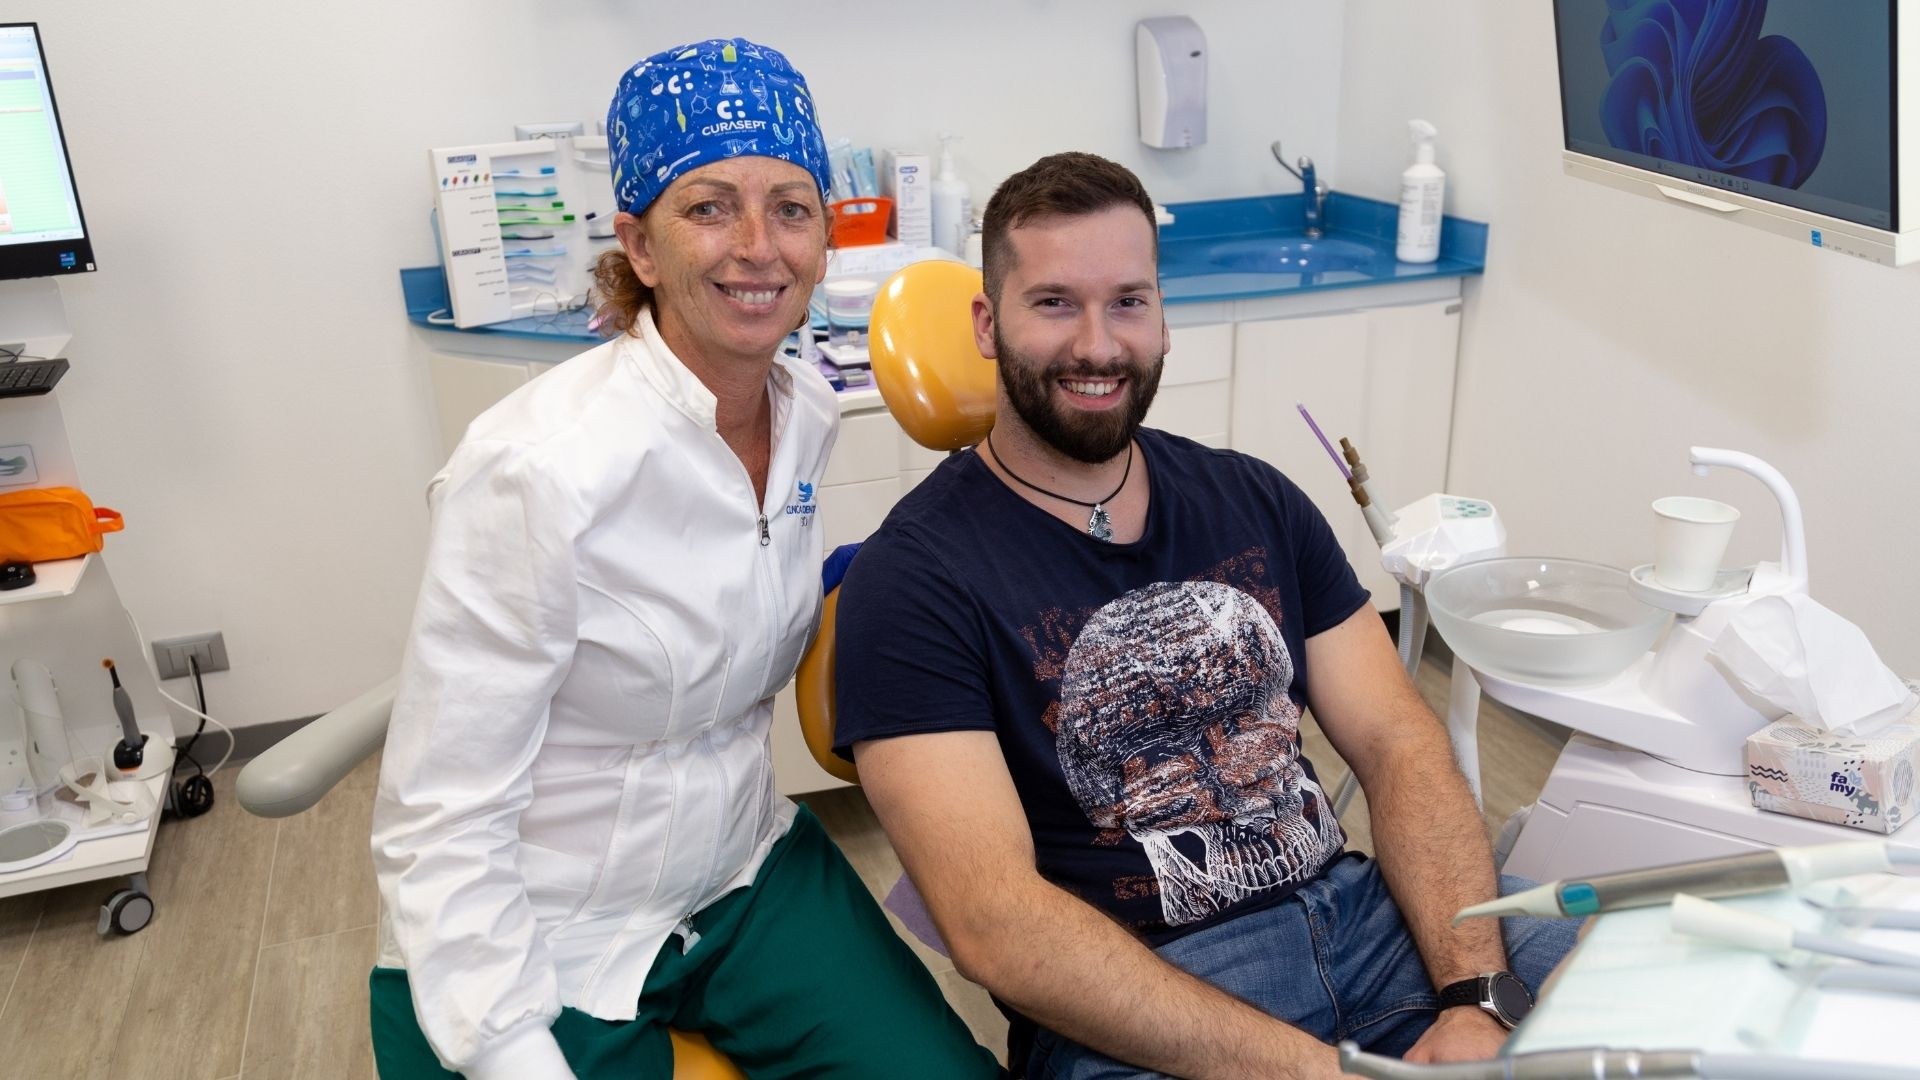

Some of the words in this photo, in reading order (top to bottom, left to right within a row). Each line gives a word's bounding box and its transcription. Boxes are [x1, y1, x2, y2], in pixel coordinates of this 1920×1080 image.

[701, 120, 766, 136] CURASEPT
[1831, 772, 1847, 784] fa
[1830, 783, 1855, 796] my
